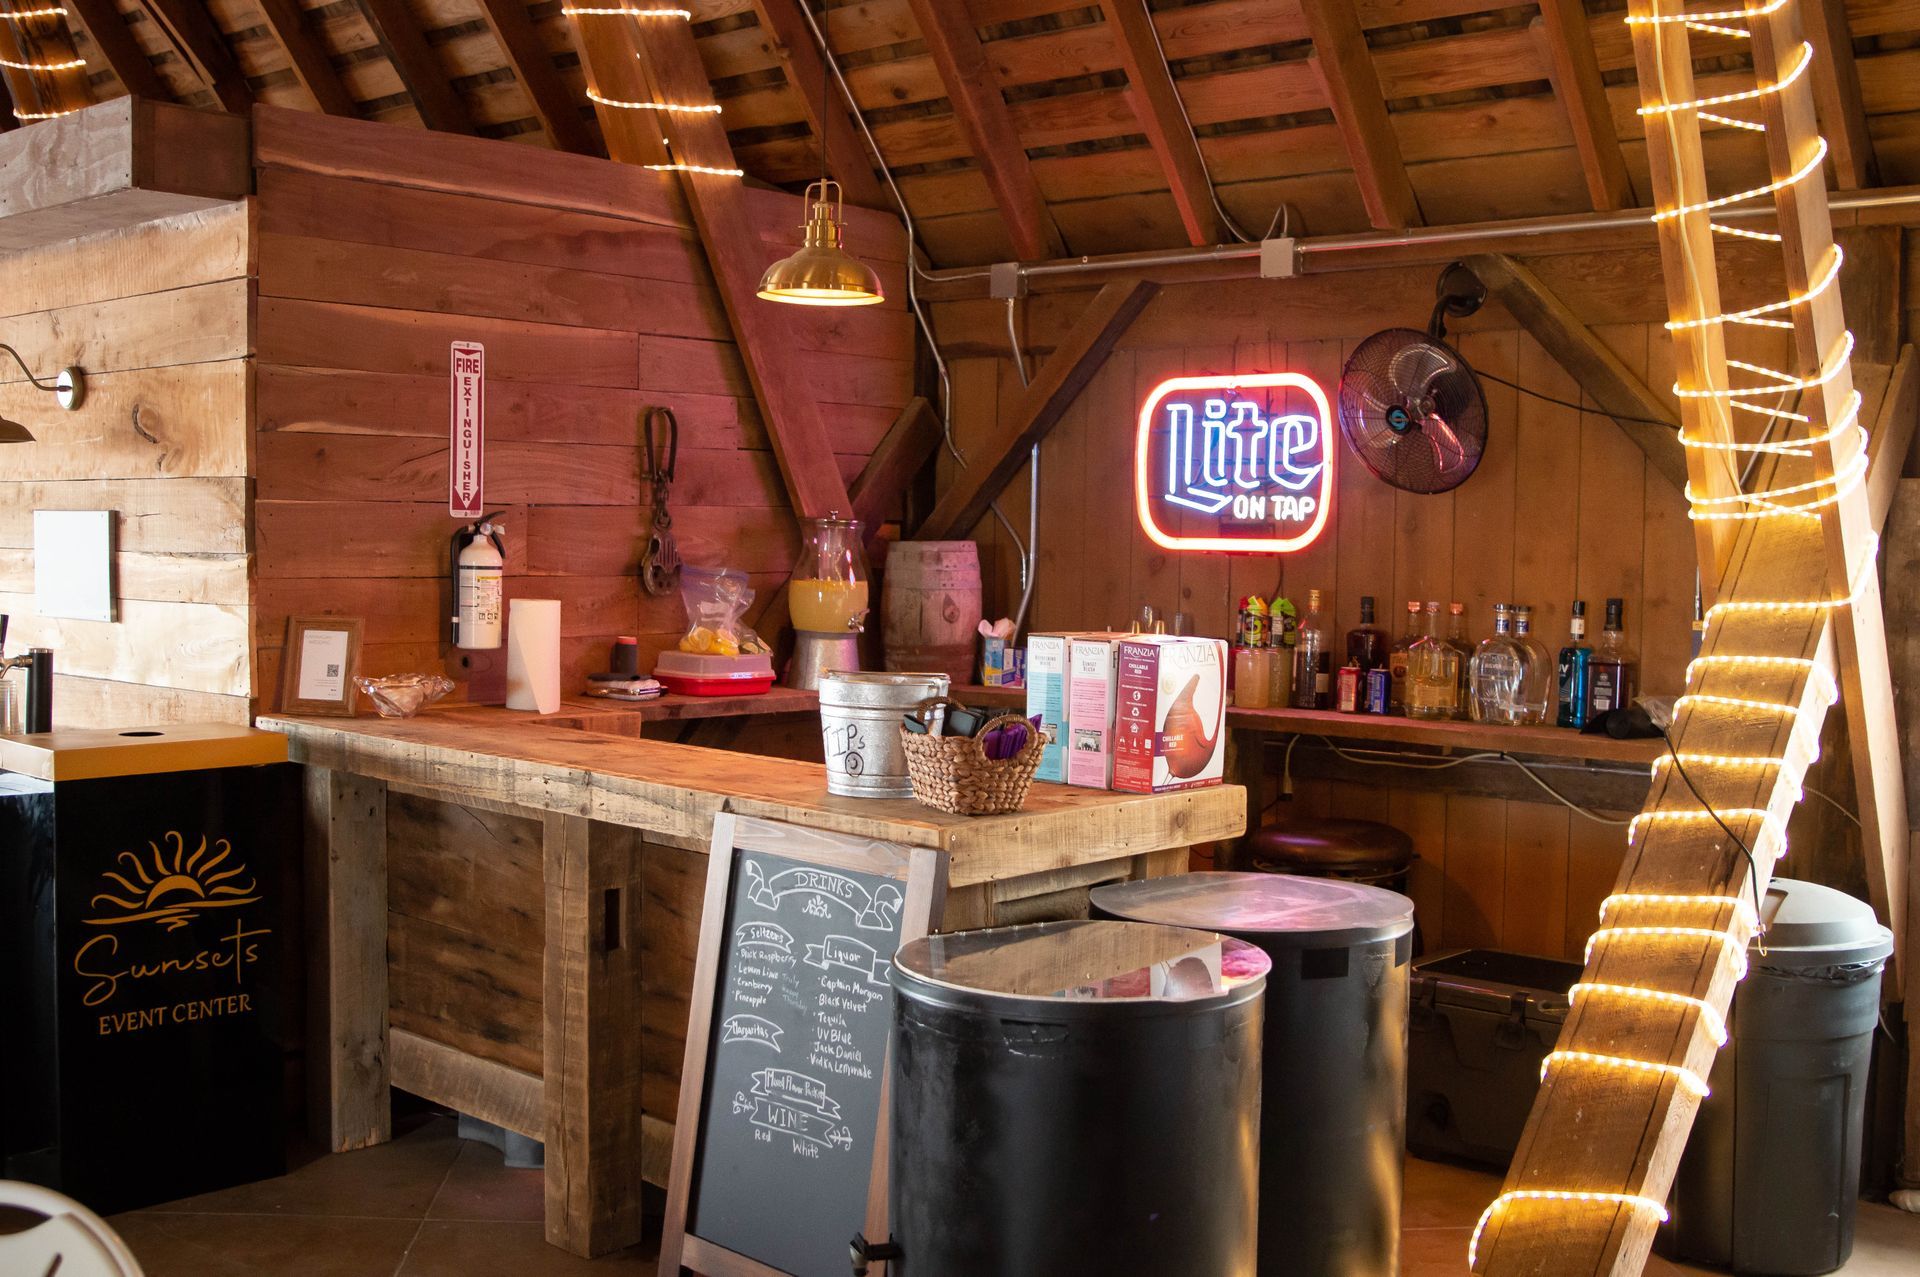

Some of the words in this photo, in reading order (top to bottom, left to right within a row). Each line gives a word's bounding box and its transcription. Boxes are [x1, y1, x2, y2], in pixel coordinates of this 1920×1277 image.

[456, 358, 480, 374] FIRE
[463, 376, 473, 501] EXTINGUISHER
[1165, 399, 1324, 513] Lite
[1234, 495, 1265, 519] ON
[1271, 495, 1315, 521] TAP
[1032, 641, 1060, 651] FRANZIA
[1075, 645, 1105, 656] FRANZIA
[1123, 646, 1156, 658] FRANZIA
[794, 872, 854, 898] DRINKS
[74, 918, 272, 1006] Sunsets
[759, 951, 797, 968] Raspberry
[827, 941, 861, 964] Liquor
[735, 990, 767, 1008] Pineapple
[821, 975, 851, 992] Captain
[852, 981, 883, 1003] Morgan
[818, 993, 840, 1006] Black
[841, 998, 867, 1013] Velvet
[100, 1006, 168, 1035] EVENT
[172, 993, 252, 1023] CENTER
[818, 1011, 847, 1028] Tequila
[814, 1041, 835, 1055] Jack
[768, 1104, 808, 1132] WINE
[755, 1129, 771, 1142] Red
[793, 1138, 819, 1158] White
